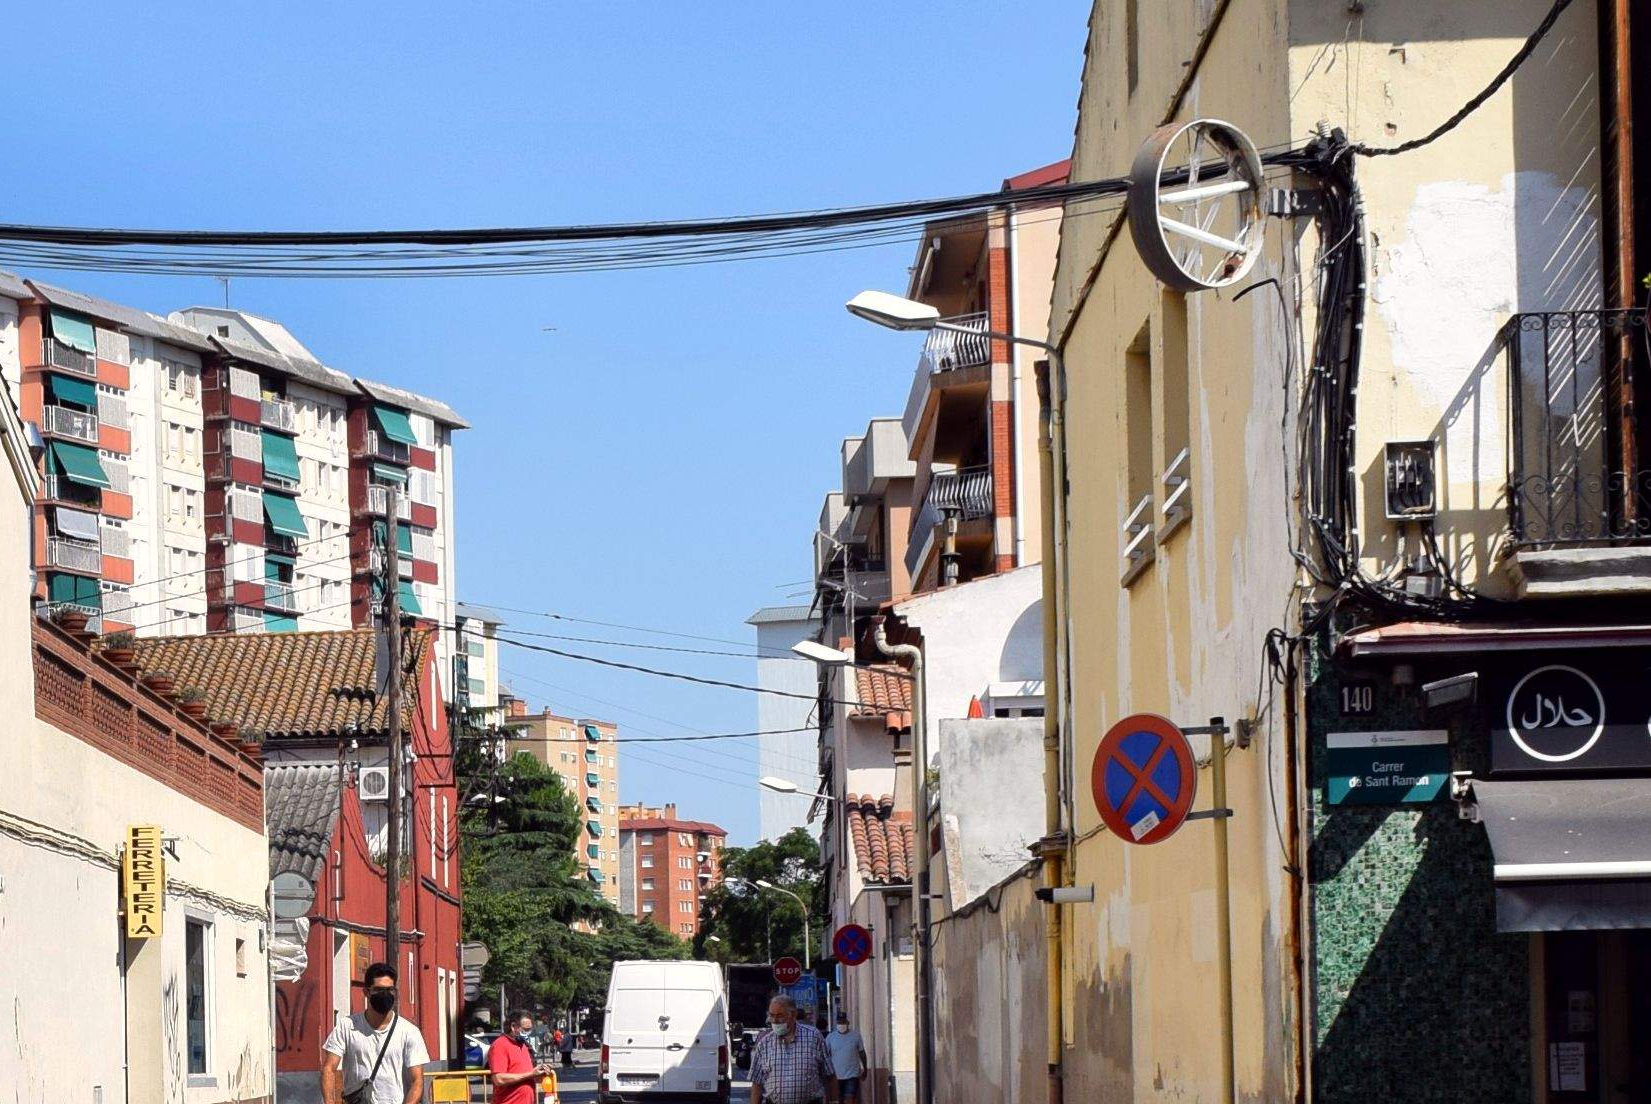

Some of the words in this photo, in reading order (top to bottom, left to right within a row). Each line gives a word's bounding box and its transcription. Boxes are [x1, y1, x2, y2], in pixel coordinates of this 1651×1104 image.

[1341, 686, 1372, 712] 140
[1521, 692, 1593, 730] حلال
[1371, 761, 1405, 773] Carrer
[1348, 776, 1362, 788] de
[1365, 776, 1390, 787] Sant
[1392, 775, 1430, 786] Ramon
[131, 826, 156, 935] FERRETERIA
[775, 967, 800, 975] STOP
